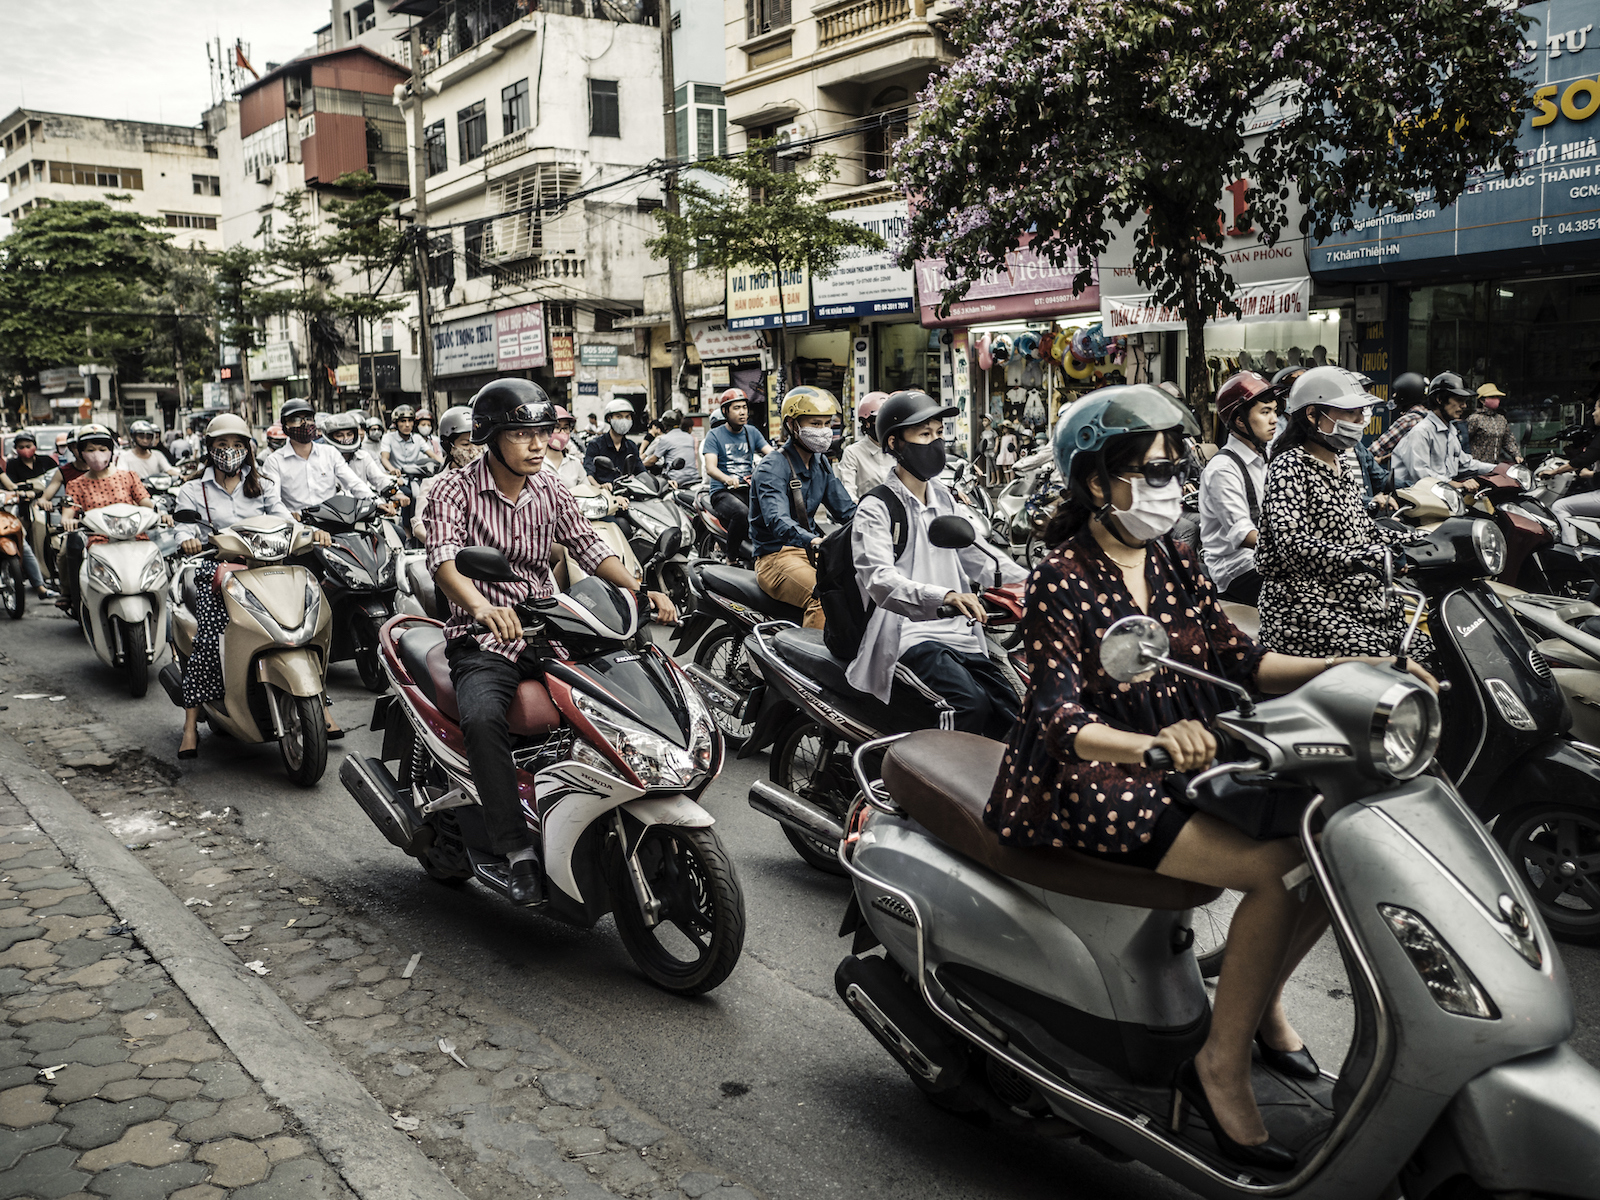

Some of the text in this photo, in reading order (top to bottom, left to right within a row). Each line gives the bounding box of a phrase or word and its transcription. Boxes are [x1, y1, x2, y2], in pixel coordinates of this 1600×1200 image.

[1561, 136, 1598, 161] NHÀ
[1487, 172, 1536, 192] THUỐC
[1539, 166, 1592, 184] THÀNH
[1415, 208, 1436, 221] Sơn
[1326, 252, 1333, 263] 7
[1333, 250, 1360, 262] Khâm
[1386, 244, 1400, 255] HN
[1259, 290, 1277, 315] GIÁ
[1279, 292, 1302, 314] 10%
[1362, 347, 1388, 372] THUỐC
[1456, 617, 1486, 637] Vespa
[581, 772, 614, 791] HONDA
